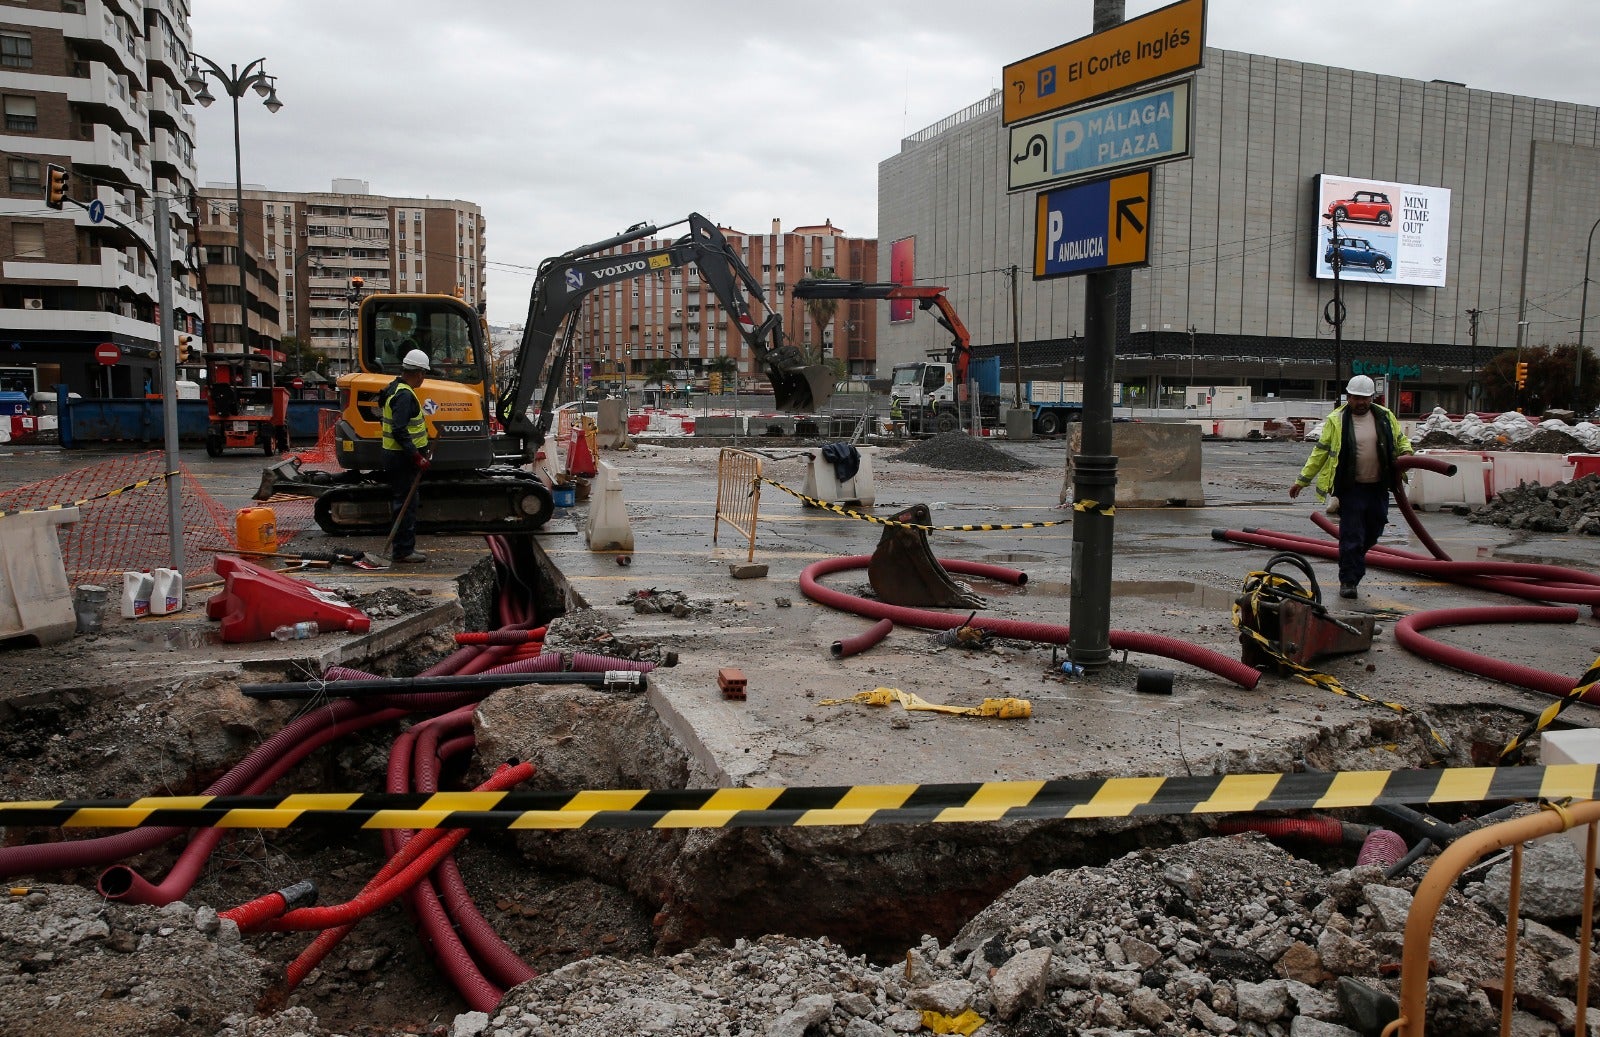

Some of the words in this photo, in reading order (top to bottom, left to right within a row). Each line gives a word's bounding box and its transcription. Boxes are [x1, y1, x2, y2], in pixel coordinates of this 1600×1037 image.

[1040, 69, 1053, 94] P
[1068, 61, 1083, 83] El
[1087, 49, 1131, 76] Corte
[1136, 27, 1190, 60] Inglés
[1055, 120, 1084, 170] P
[1088, 99, 1171, 138] MÁLAGA
[1097, 132, 1160, 162] PLAZA
[1404, 196, 1429, 210] MINI
[1403, 209, 1429, 222] TIME
[1402, 222, 1424, 234] OUT
[1058, 236, 1103, 263] ANDALUCIA
[592, 260, 646, 279] VOLVO
